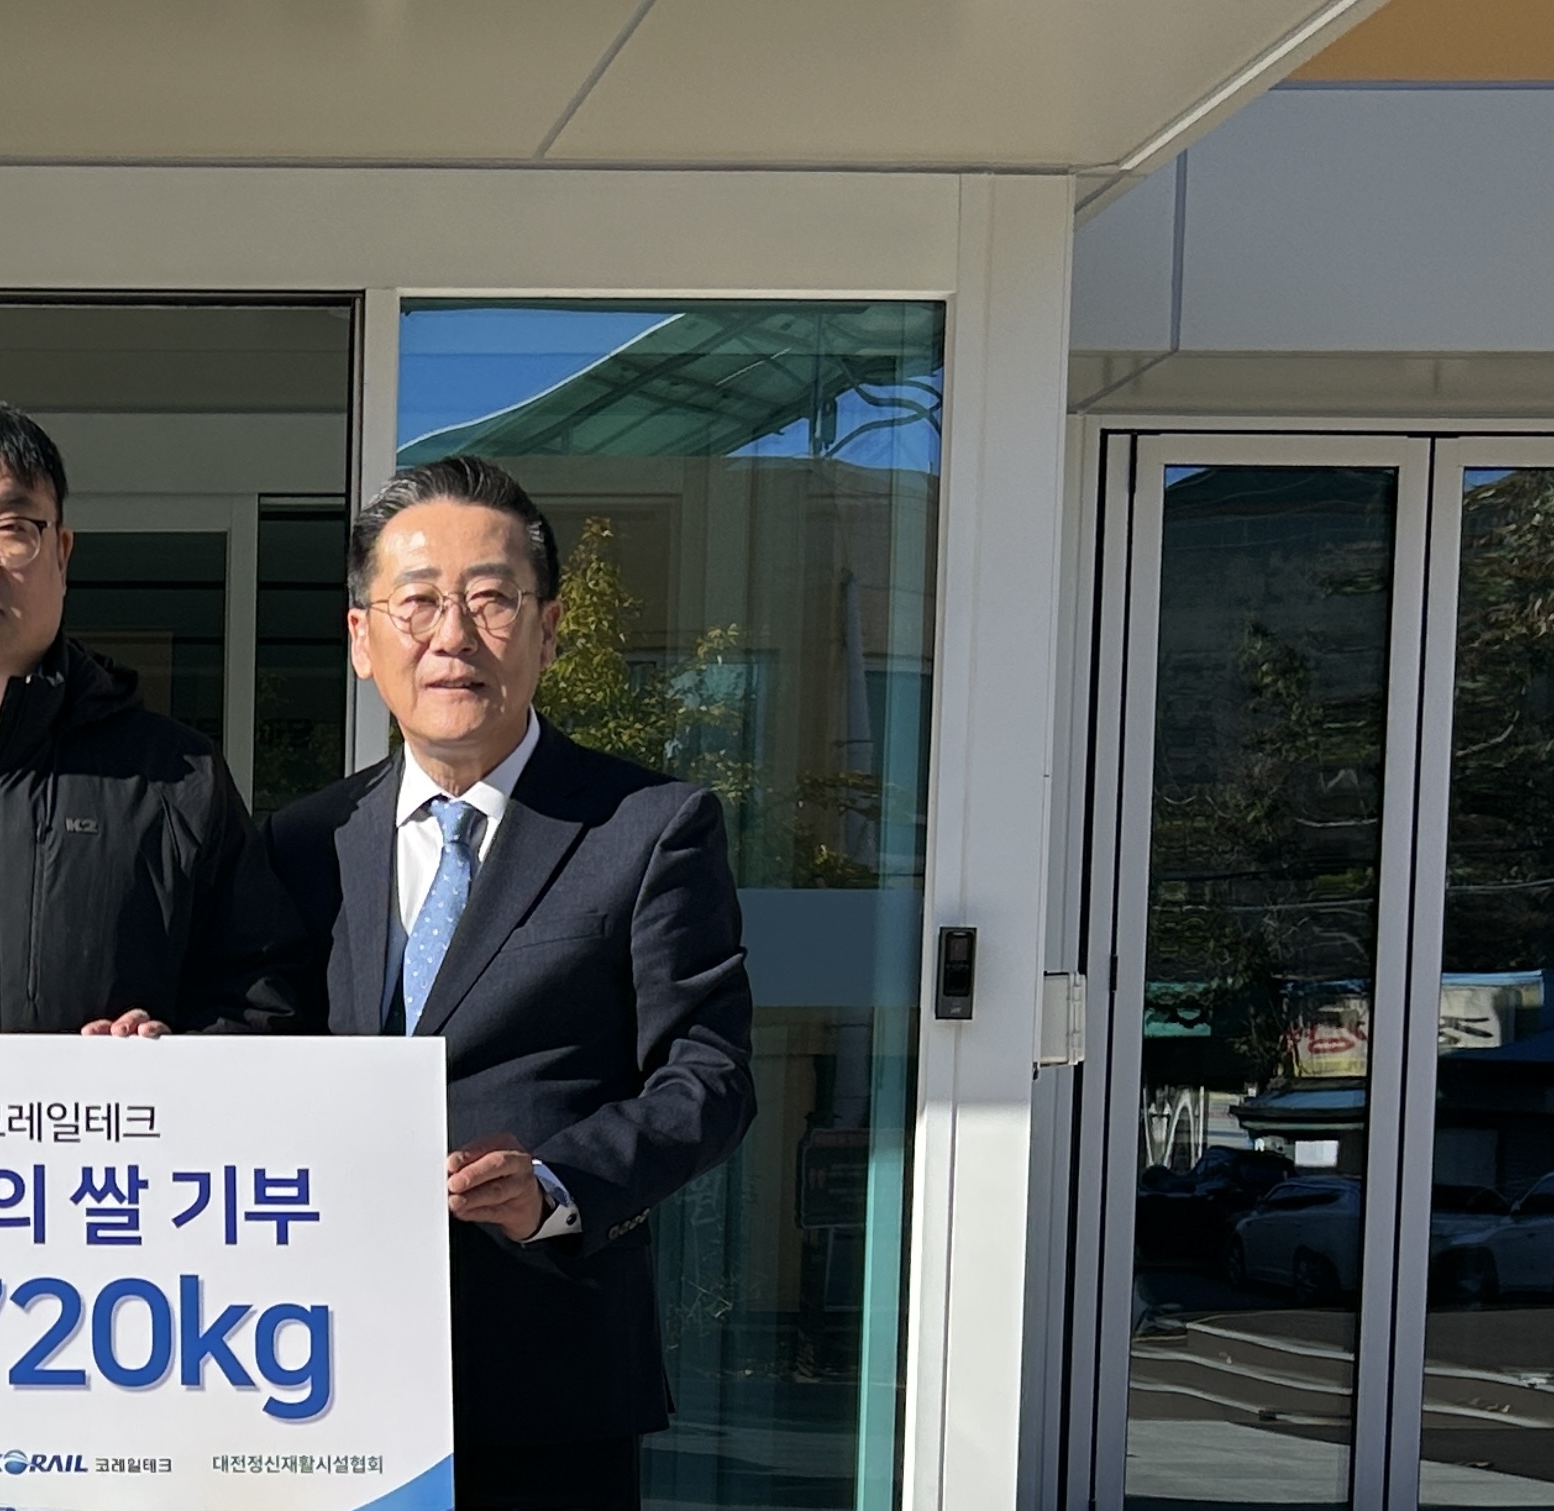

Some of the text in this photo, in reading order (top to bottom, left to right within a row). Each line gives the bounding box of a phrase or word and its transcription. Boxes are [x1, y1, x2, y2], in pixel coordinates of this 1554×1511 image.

[65, 818, 98, 833] K2
[69, 1165, 149, 1246] 쌀
[171, 1167, 321, 1247] 기부
[95, 1458, 172, 1473] 코레일테크
[212, 1454, 384, 1474] 대전정신재활시설협회
